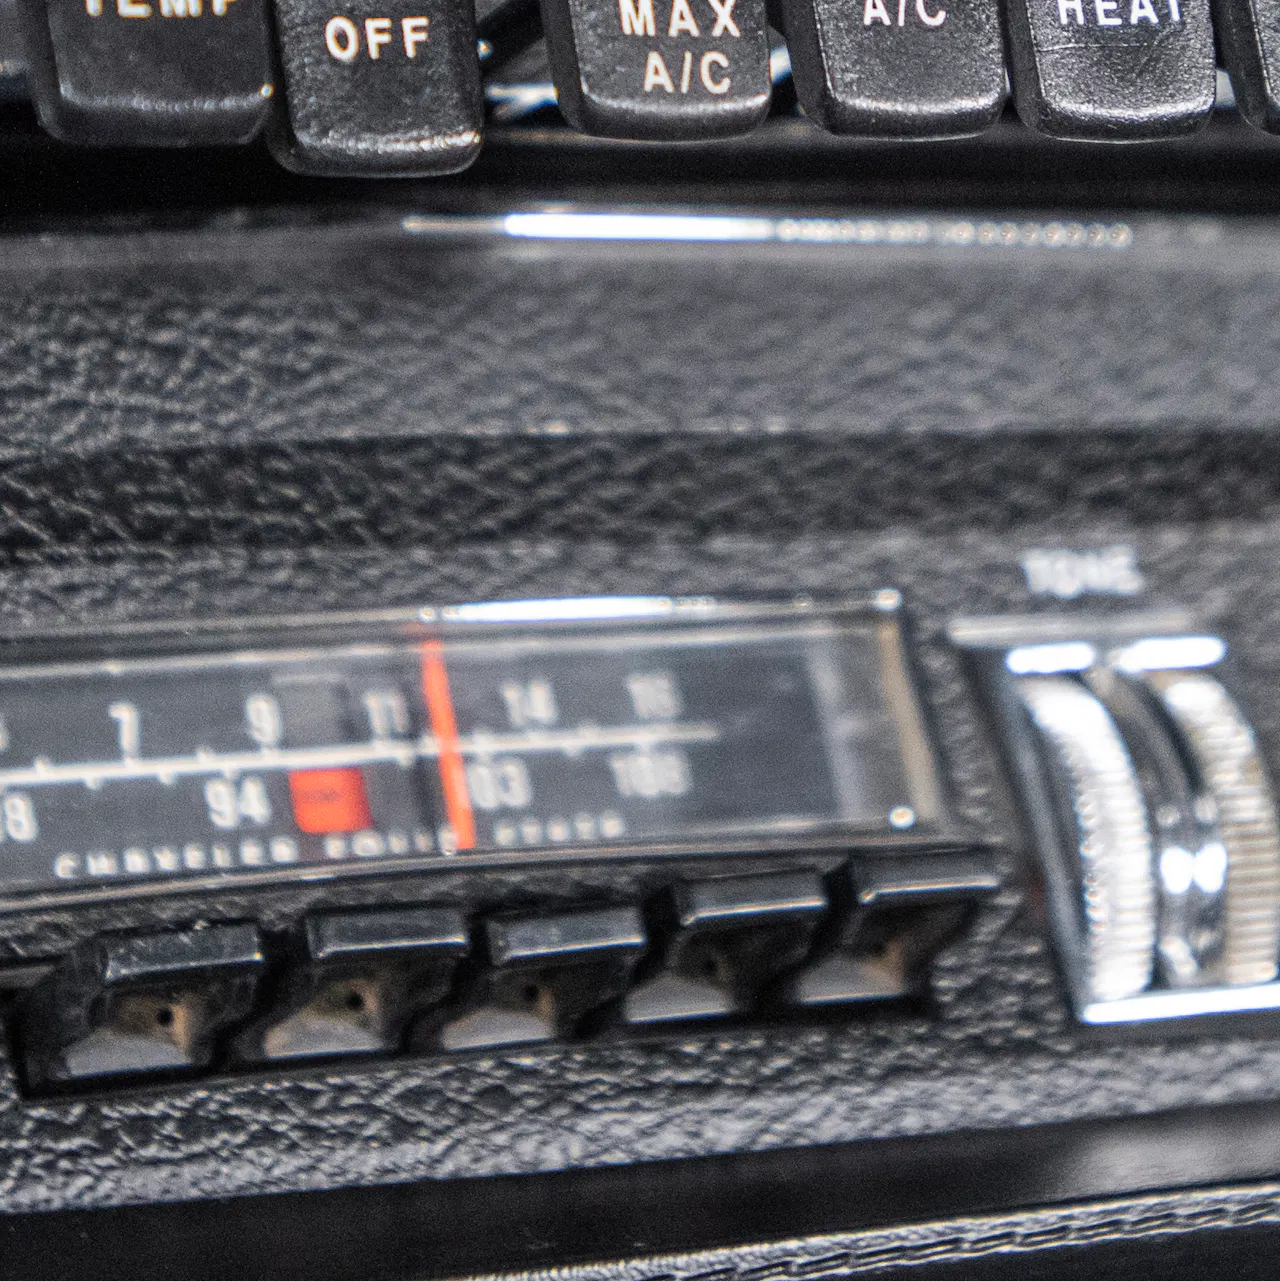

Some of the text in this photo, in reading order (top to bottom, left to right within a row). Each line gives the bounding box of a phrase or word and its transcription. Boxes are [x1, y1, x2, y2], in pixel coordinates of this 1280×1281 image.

[323, 15, 431, 63] OFF
[642, 50, 734, 96] A/C
[245, 692, 283, 746] 9
[204, 775, 271, 829] 94
